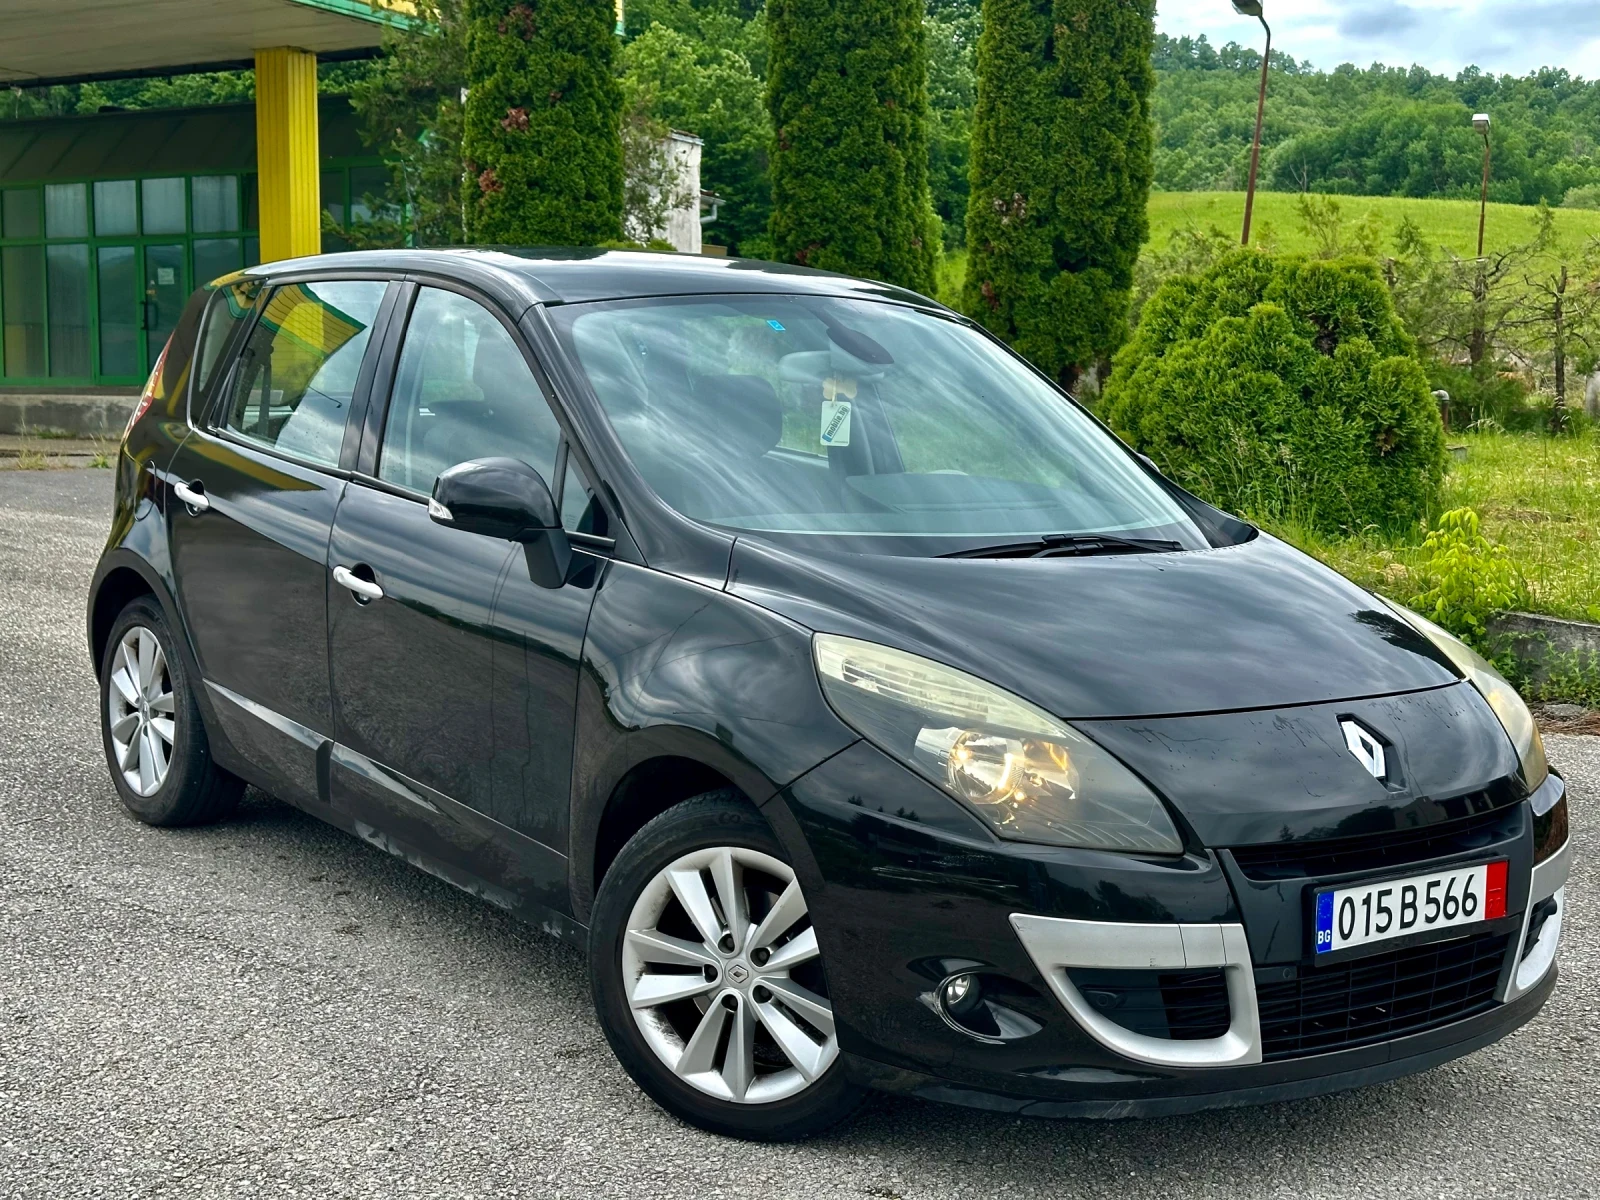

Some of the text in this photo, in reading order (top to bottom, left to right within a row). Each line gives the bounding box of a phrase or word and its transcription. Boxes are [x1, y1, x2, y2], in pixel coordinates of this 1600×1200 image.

[827, 406, 848, 437] mobile.bg
[1338, 873, 1478, 941] 015B566
[1317, 929, 1331, 945] BG
